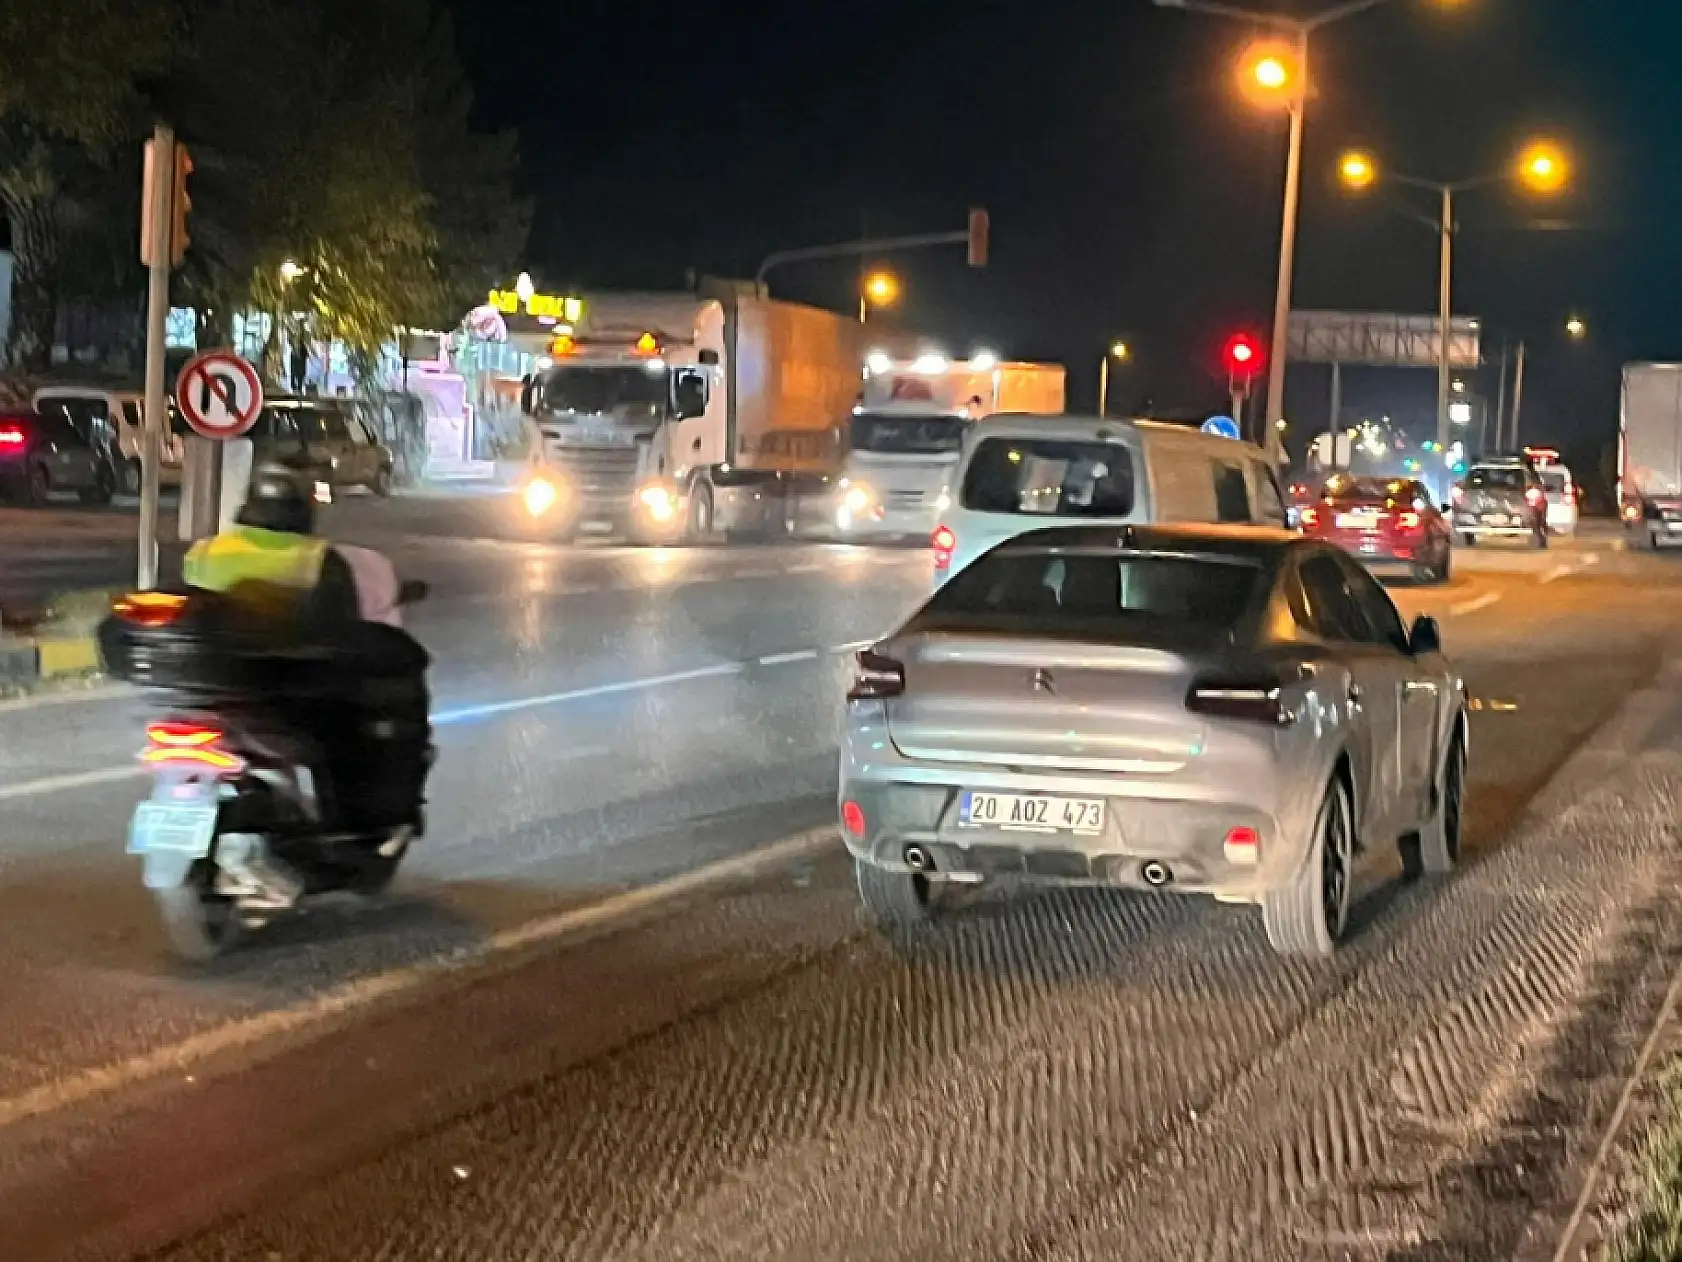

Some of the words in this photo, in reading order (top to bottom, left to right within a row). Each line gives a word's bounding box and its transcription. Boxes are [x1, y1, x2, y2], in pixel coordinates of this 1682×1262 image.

[973, 796, 997, 819] 20
[1010, 798, 1048, 823] AOZ
[1063, 801, 1101, 826] 473
